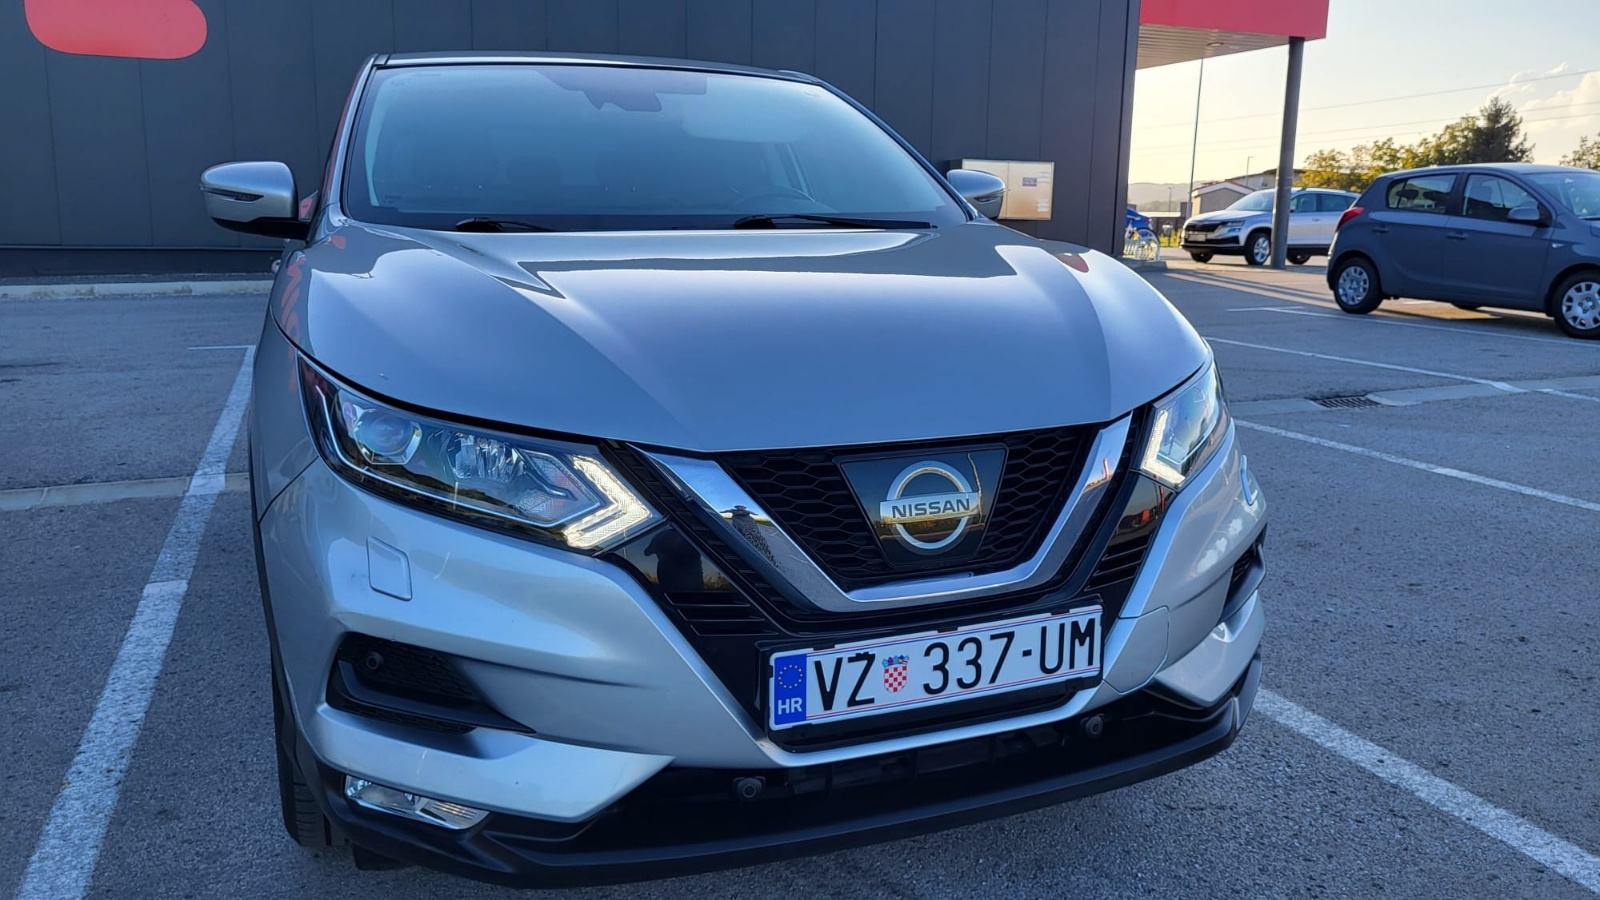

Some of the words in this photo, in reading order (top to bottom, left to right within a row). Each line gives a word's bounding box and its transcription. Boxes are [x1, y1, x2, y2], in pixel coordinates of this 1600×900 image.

[891, 498, 970, 518] NISSAN
[923, 618, 1096, 695] 337-UM
[777, 698, 803, 715] HR
